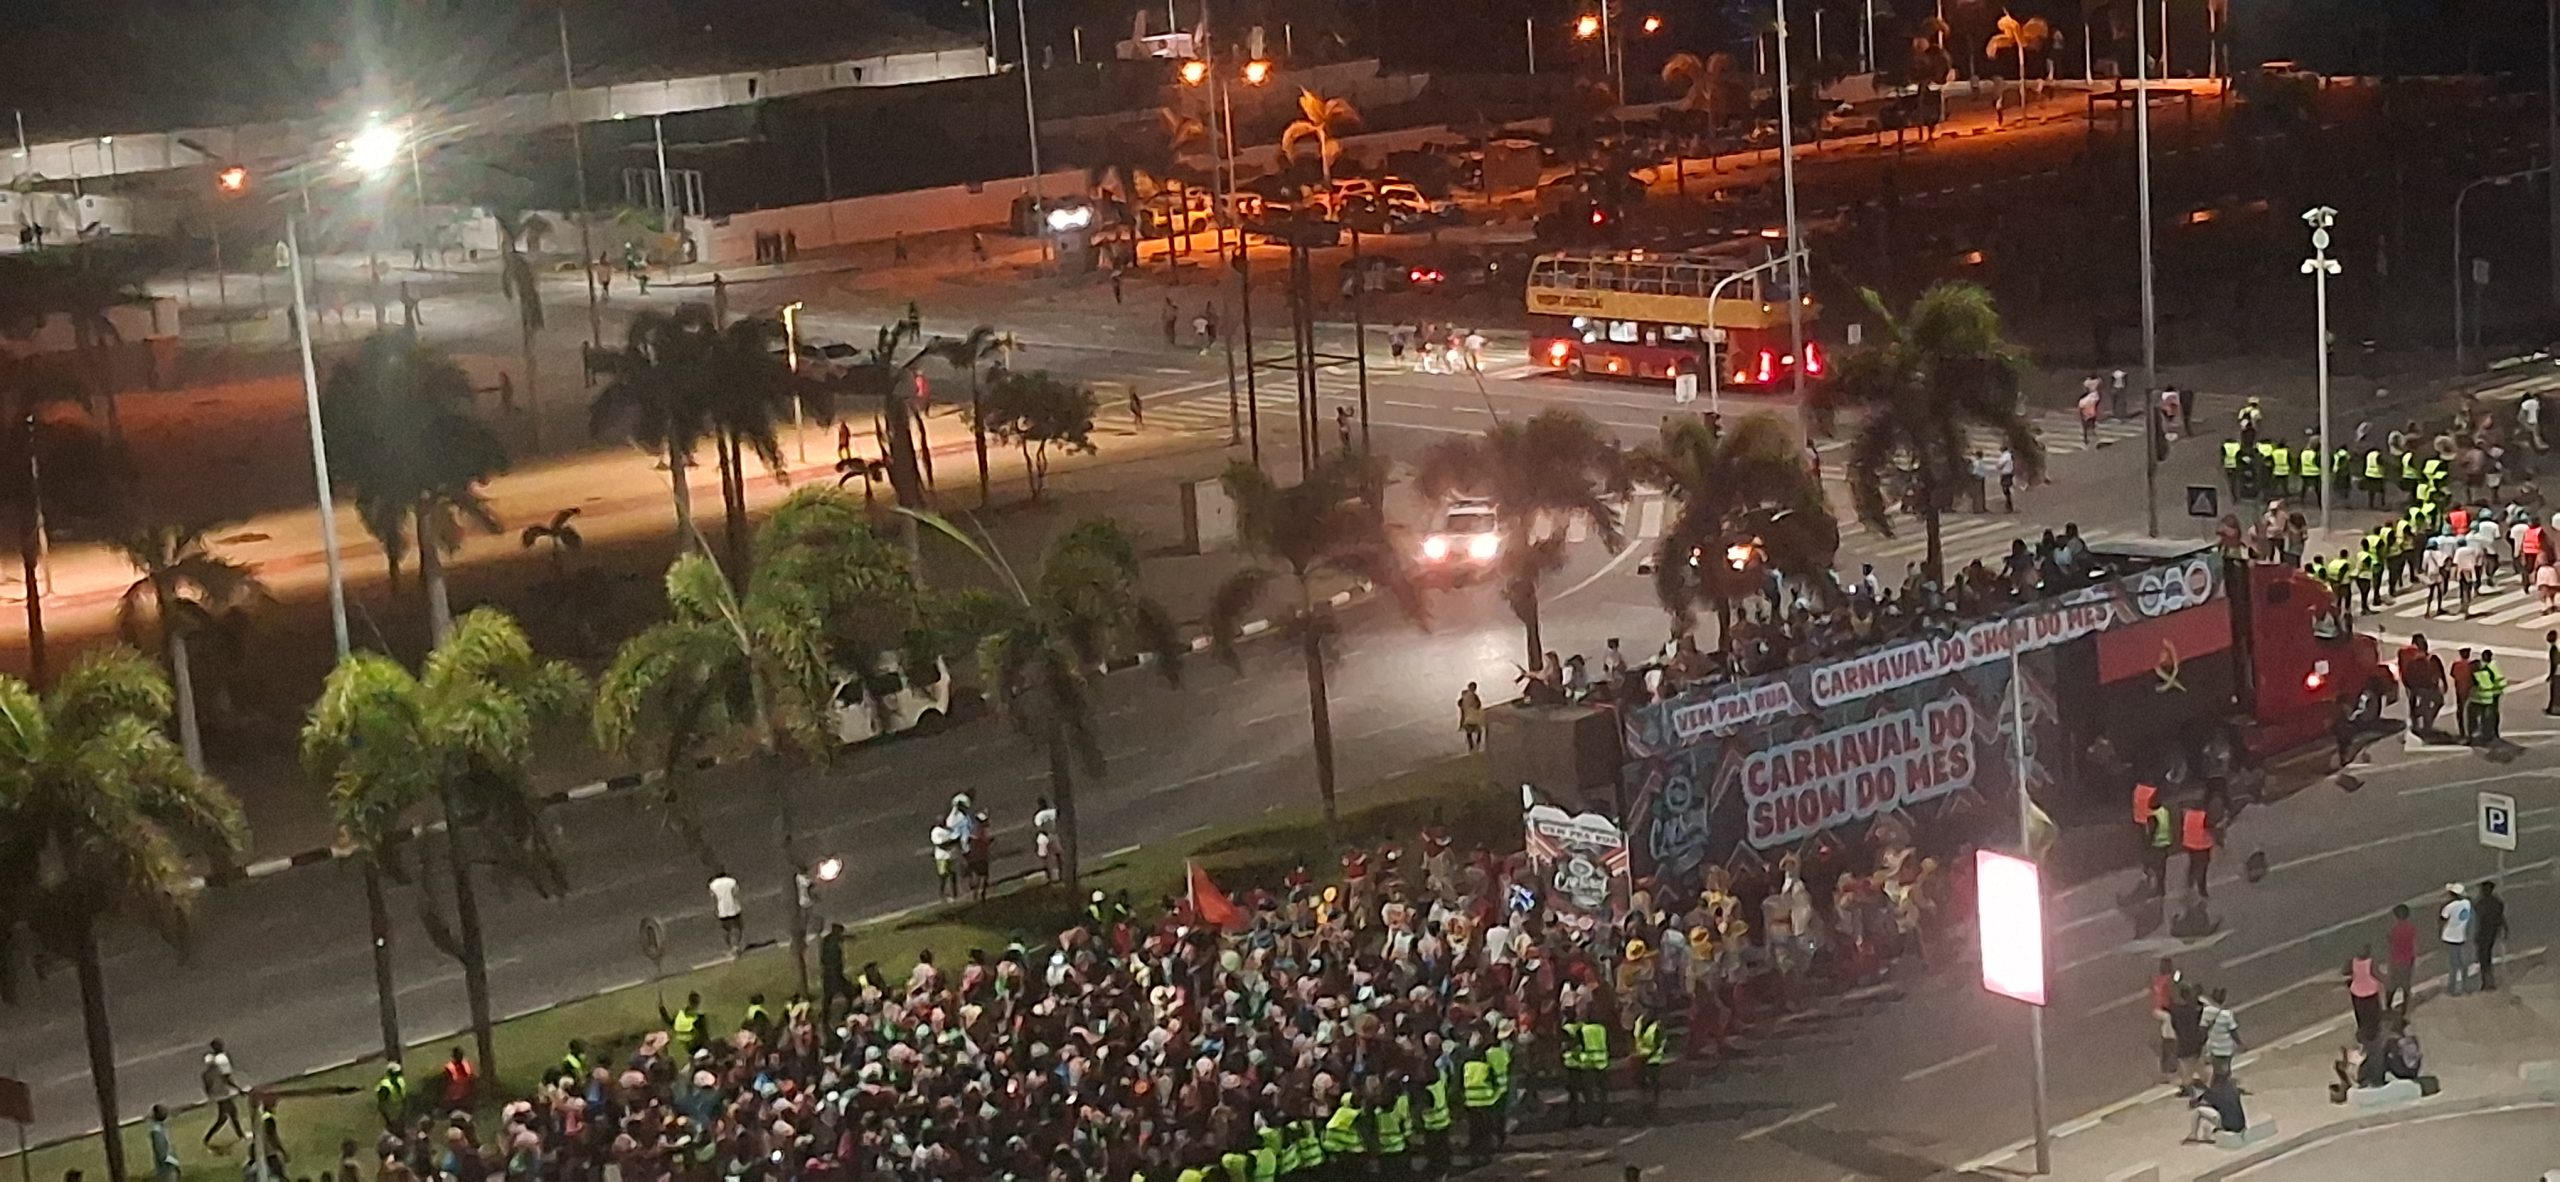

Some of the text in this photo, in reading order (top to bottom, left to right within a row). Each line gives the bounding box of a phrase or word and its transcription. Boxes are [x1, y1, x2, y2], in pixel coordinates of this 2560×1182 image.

[1815, 647, 1933, 699] CARNAVAL
[1938, 637, 1966, 667] DO
[1971, 619, 2029, 657] SHOW
[2036, 613, 2061, 639] DO
[1676, 685, 1788, 731] VEM PRA RUA
[1748, 717, 1921, 797] CARNAVAL
[1929, 703, 1967, 745] DO
[1752, 779, 1847, 840] SHOW
[1856, 766, 1897, 810] DO
[2489, 808, 2505, 831] P
